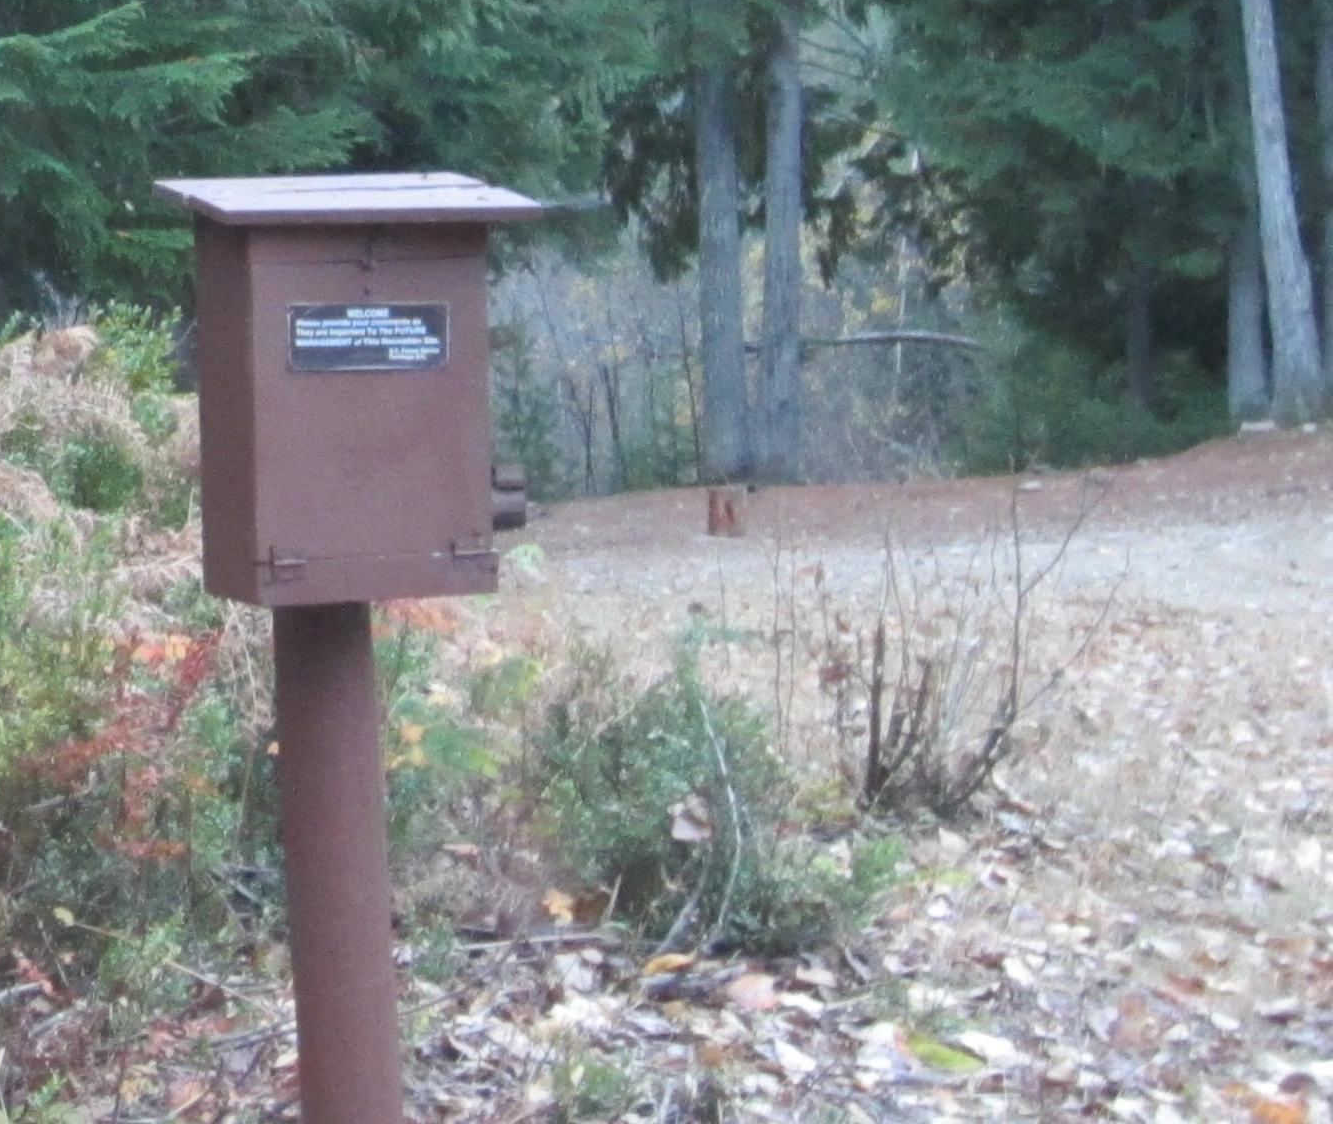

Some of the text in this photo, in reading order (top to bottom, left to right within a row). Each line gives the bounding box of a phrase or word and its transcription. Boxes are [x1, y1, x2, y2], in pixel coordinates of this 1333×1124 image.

[347, 308, 390, 318] WELCOME
[394, 325, 426, 335] FUTURE
[295, 337, 352, 347] MANAGEMENT
